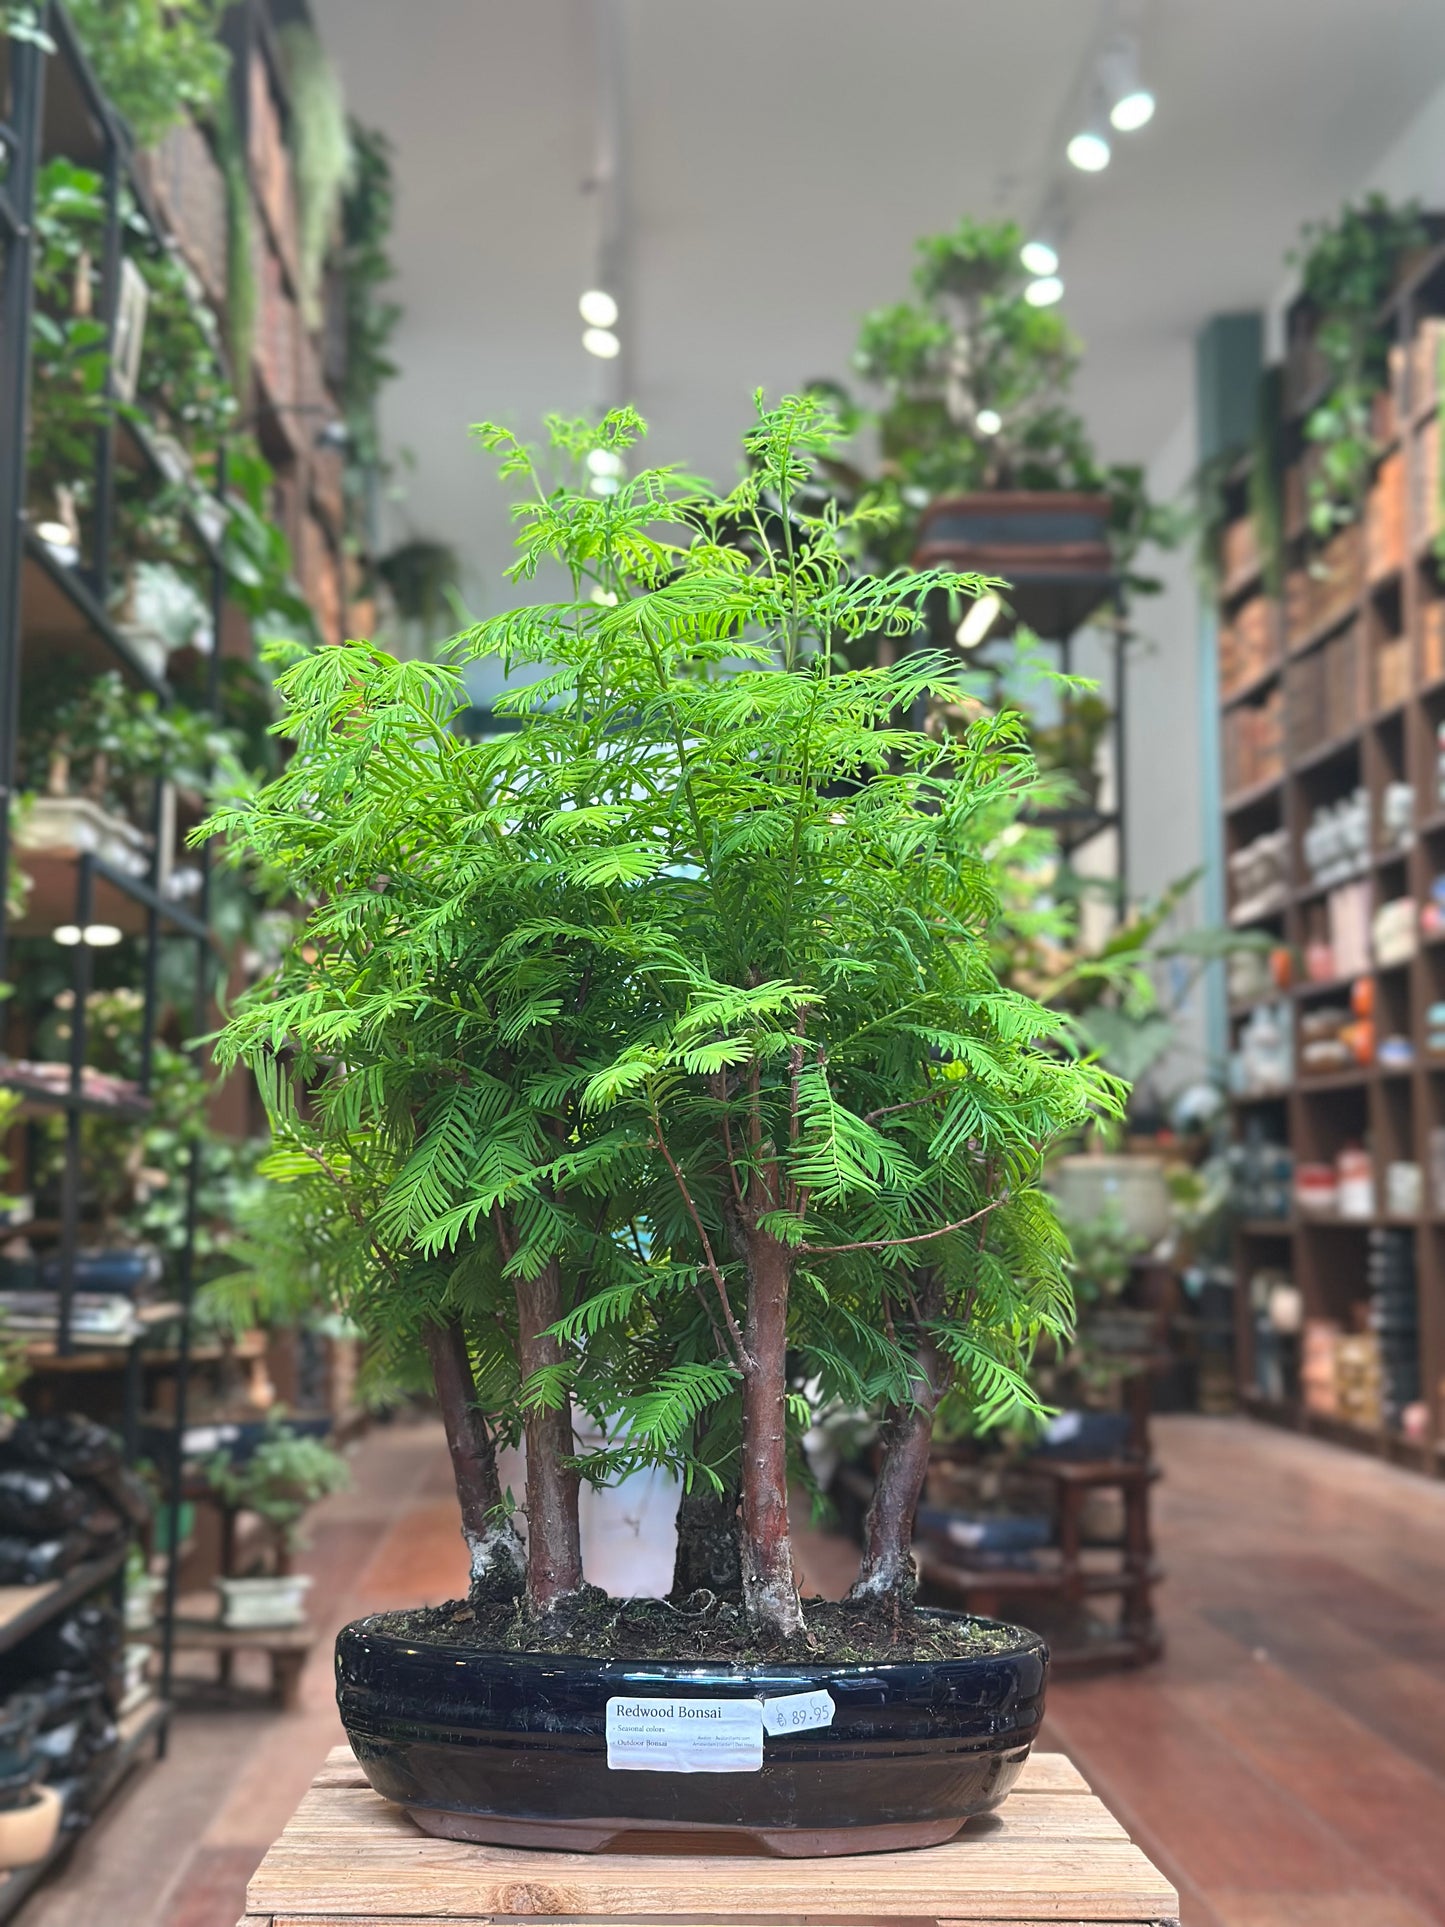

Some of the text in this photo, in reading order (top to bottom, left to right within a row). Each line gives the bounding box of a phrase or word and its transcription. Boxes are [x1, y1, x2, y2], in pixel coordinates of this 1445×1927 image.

[617, 1704, 721, 1718] Redwood Bonsai
[792, 1705, 829, 1724] 89.95
[645, 1725, 665, 1733] colors
